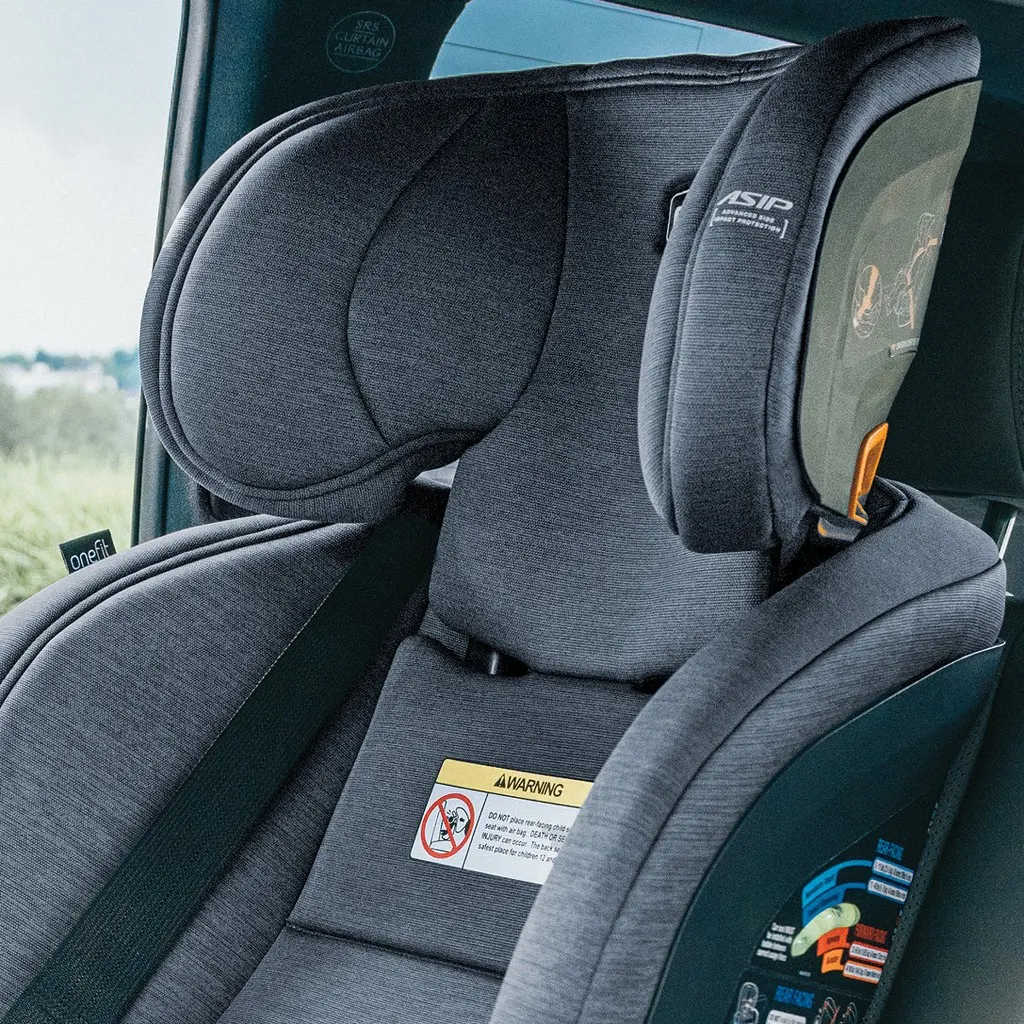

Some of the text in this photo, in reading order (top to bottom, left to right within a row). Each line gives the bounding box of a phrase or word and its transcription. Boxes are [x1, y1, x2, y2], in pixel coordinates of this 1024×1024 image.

[356, 20, 380, 31] SRS
[335, 31, 390, 47] CURTAIN
[333, 43, 382, 58] AIRBAG
[717, 190, 794, 211] ASIP
[70, 538, 110, 571] onefit
[506, 776, 564, 798] WARNING
[488, 811, 497, 820] DO
[497, 813, 511, 822] NOT
[509, 816, 524, 825] place
[552, 823, 566, 832] child
[481, 831, 502, 841] INJURY
[484, 822, 497, 830] seat
[497, 824, 509, 833] with
[529, 830, 548, 840] DEATH
